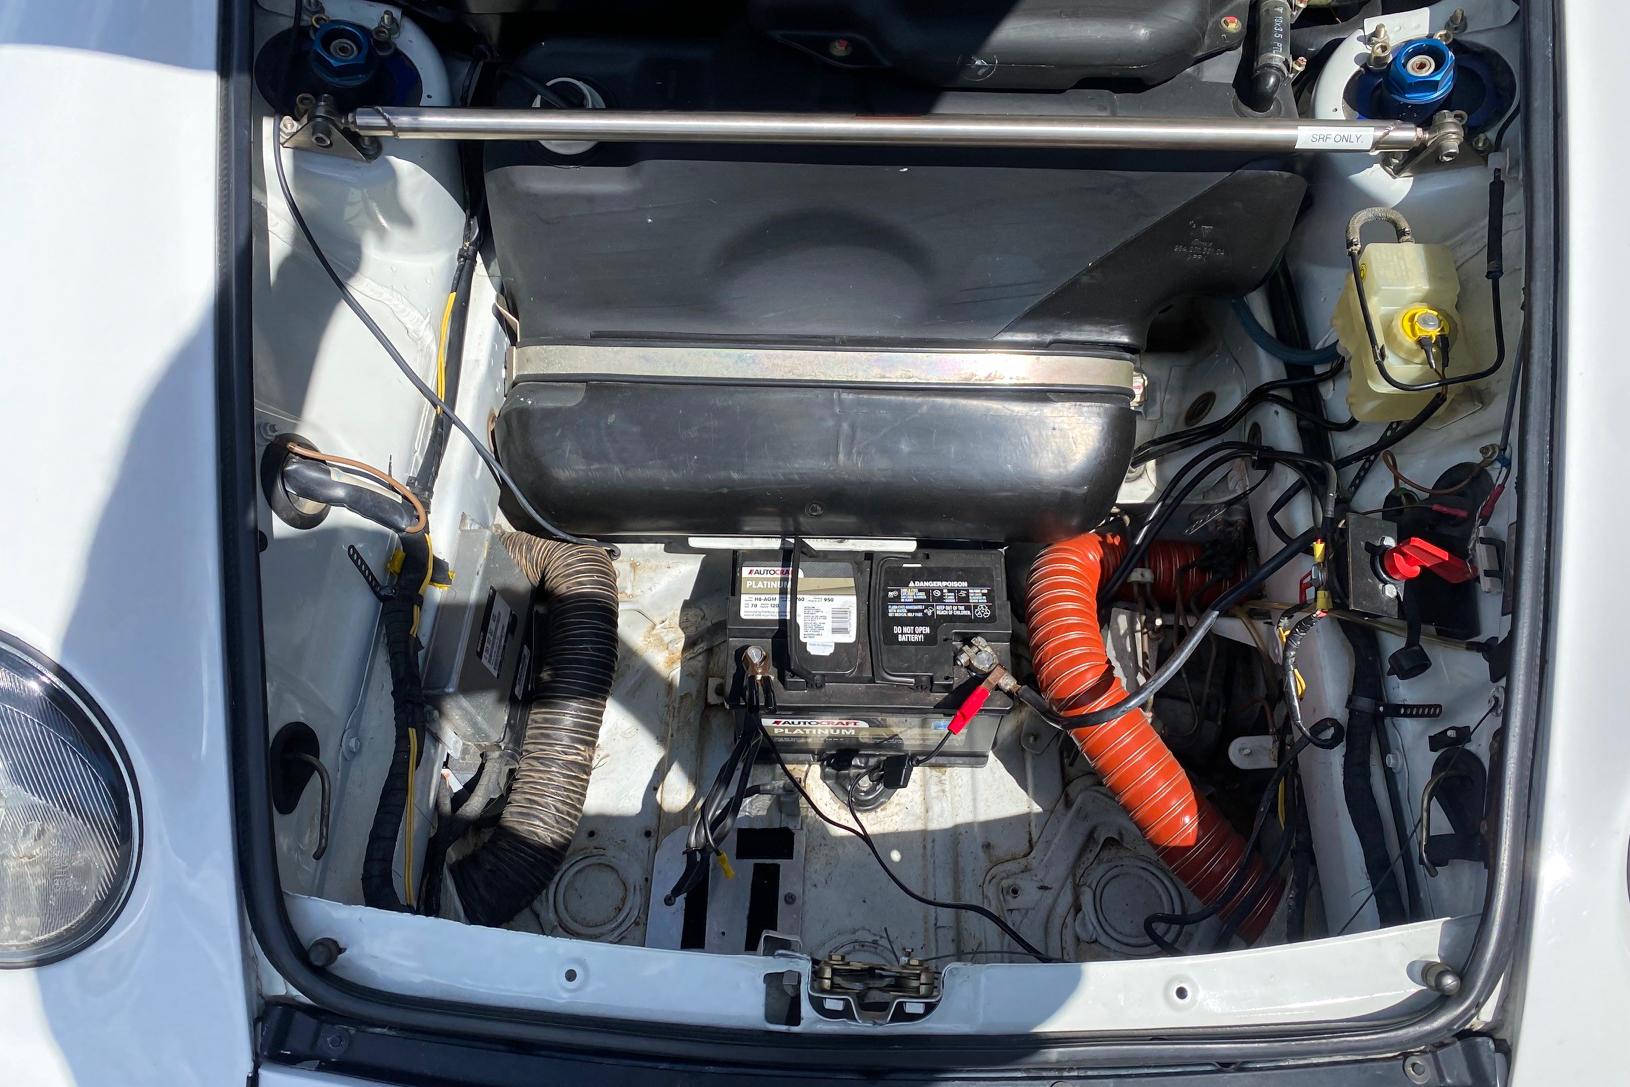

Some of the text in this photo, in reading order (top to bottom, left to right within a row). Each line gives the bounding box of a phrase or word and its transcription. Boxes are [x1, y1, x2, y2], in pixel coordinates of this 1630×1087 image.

[1311, 133, 1331, 143] SRF
[754, 568, 791, 576] AUTOCRA
[893, 626, 930, 634] DO NOT OPEN
[898, 634, 924, 642] BATTERY!
